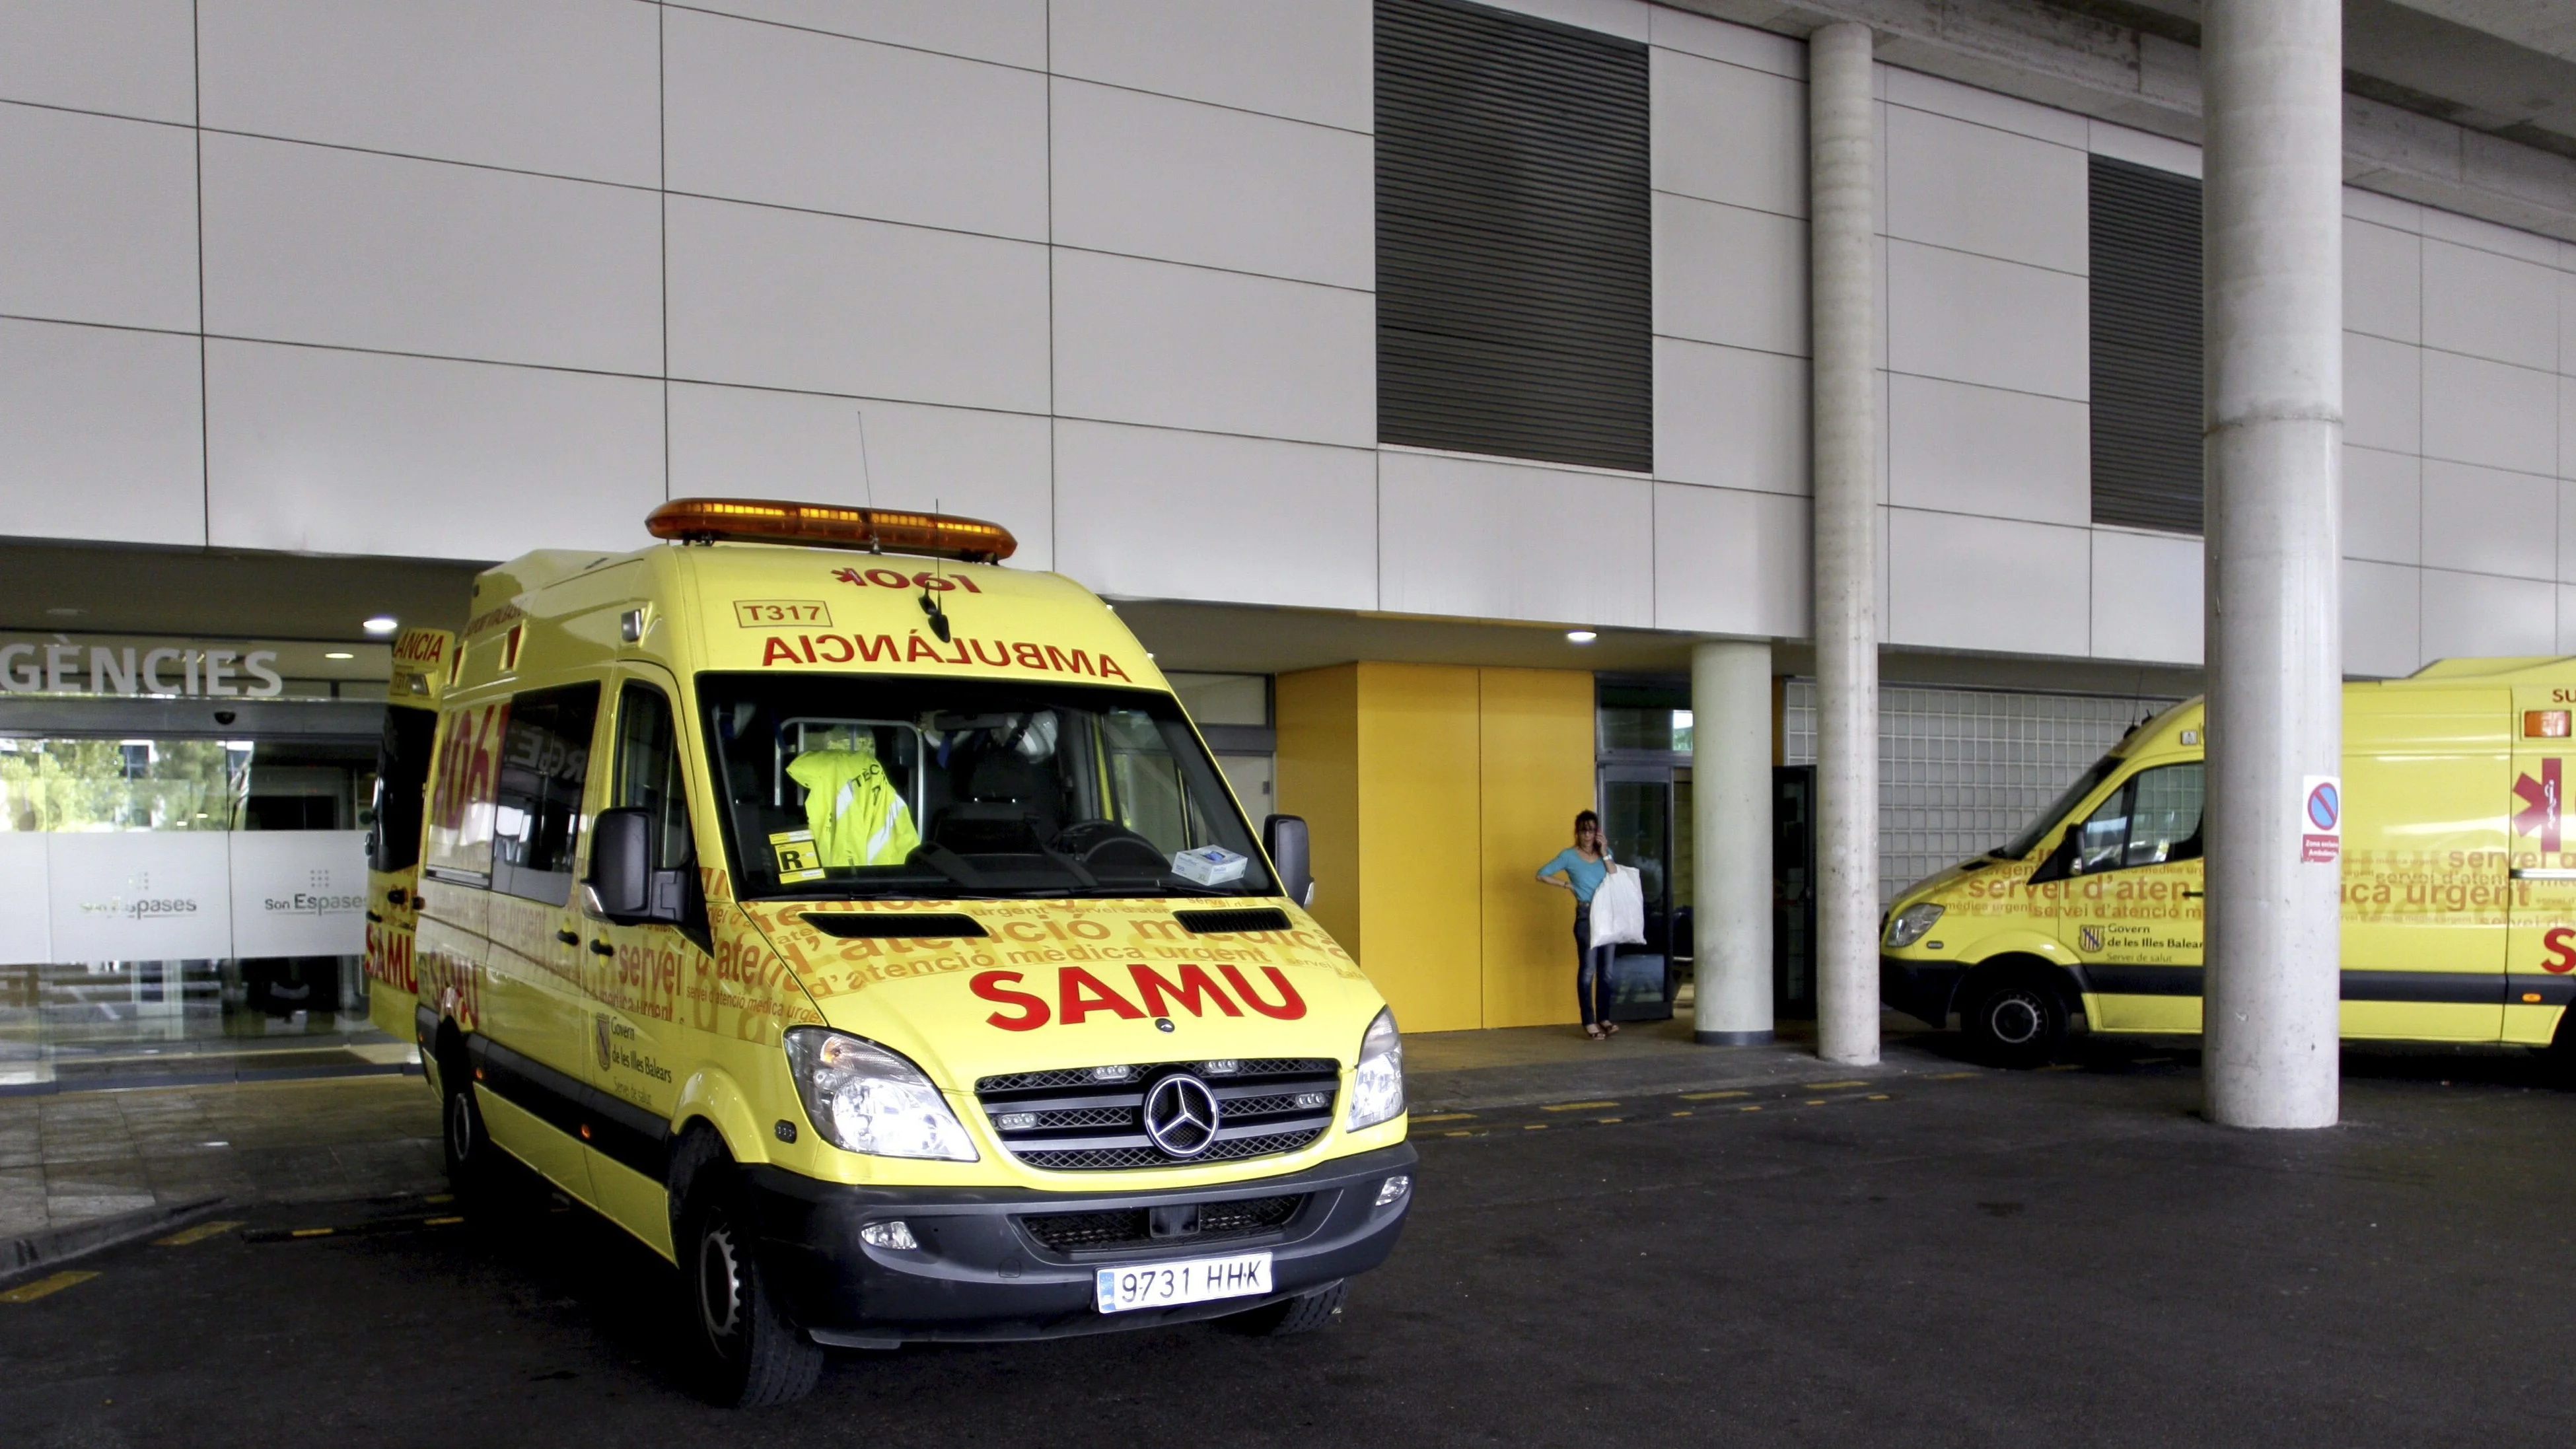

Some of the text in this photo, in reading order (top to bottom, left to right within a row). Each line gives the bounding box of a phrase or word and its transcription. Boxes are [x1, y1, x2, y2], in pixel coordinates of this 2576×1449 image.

[864, 568, 982, 594] 061
[742, 605, 821, 621] T317
[0, 635, 283, 697] GÈNCIES
[779, 850, 804, 870] R
[265, 898, 290, 910] Son
[2406, 884, 2530, 912] urgent
[972, 905, 1049, 918] urgent
[2108, 923, 2150, 934] Govern
[2107, 938, 2119, 947] de
[2124, 937, 2139, 947] les
[2142, 937, 2164, 948] Illes
[365, 923, 418, 995] SAMU
[618, 938, 686, 997] servei
[806, 944, 1272, 999] d'atenció mèdica urgent
[970, 964, 1307, 1032] SAMU
[610, 1016, 635, 1042] Govern
[1122, 1259, 1262, 1302] 9731 HHK
